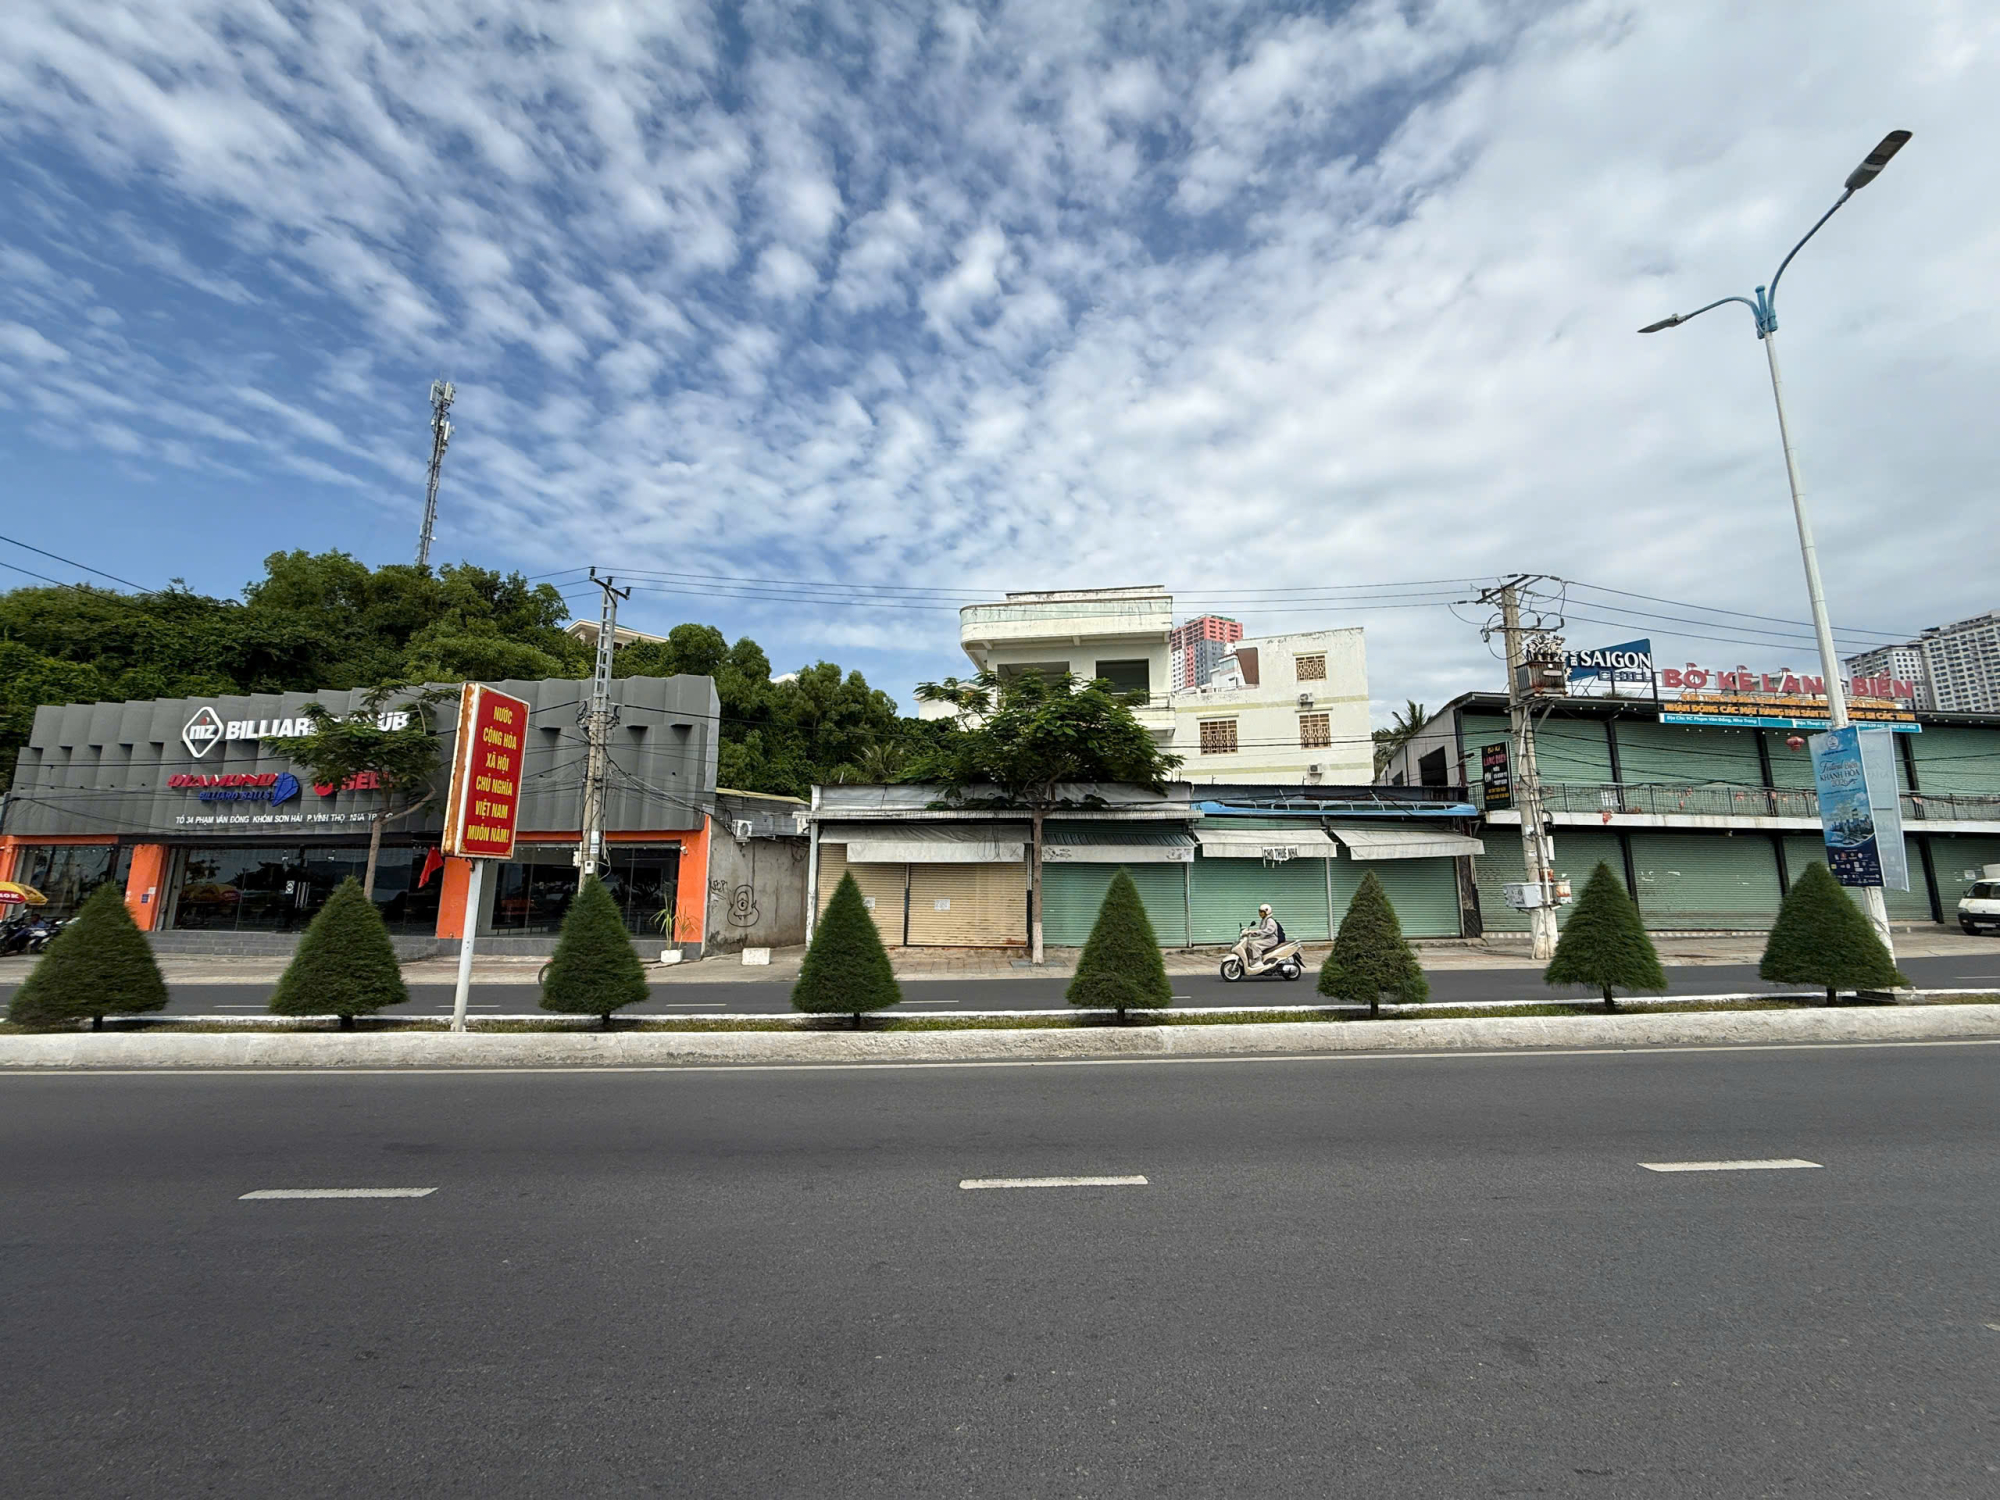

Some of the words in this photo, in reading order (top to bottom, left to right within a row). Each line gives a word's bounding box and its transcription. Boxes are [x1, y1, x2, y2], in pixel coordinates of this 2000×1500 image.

[1580, 650, 1652, 669] SAIGON
[1761, 667, 1826, 695] LÀN
[493, 705, 513, 725] NƯỚC
[482, 725, 503, 746] CỘNG
[503, 731, 517, 750] HÒA
[485, 751, 496, 769] XÃ
[497, 754, 510, 774] HỘI
[167, 773, 279, 787] DIAMOND
[475, 772, 491, 792] CHỦ
[491, 778, 513, 796] NGHĨA
[199, 791, 238, 801] BILLIARD
[475, 798, 491, 820] VIỆT
[491, 803, 509, 819] NAM
[186, 816, 194, 824] 34
[195, 815, 214, 826] PHẠM
[253, 814, 273, 823] KHÓM
[331, 813, 345, 824] THỌ
[349, 813, 365, 822] NHA
[466, 823, 490, 841] MUÔN
